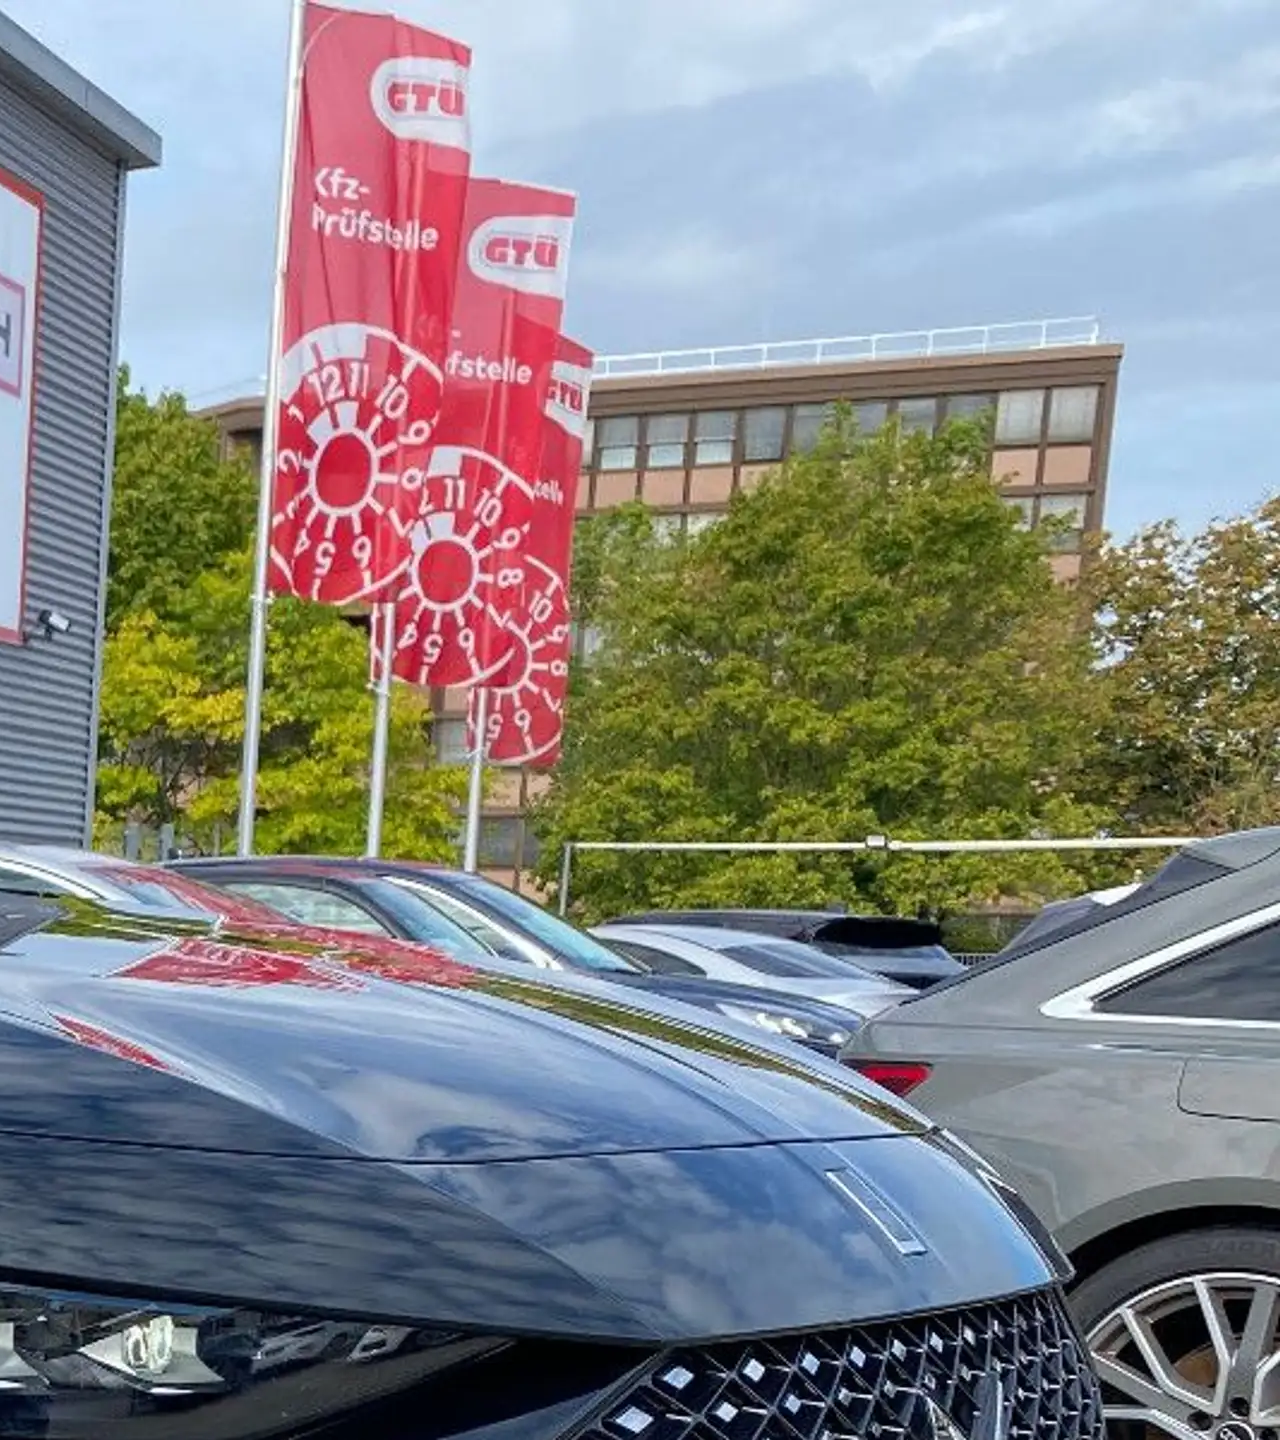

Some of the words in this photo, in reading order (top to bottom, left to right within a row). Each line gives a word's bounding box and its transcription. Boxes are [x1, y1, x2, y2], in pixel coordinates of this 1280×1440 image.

[308, 365, 345, 406] 12
[375, 374, 408, 419] 10
[444, 477, 465, 510] 11
[474, 488, 502, 527] 10
[497, 568, 524, 587] 8
[529, 590, 553, 623] 10
